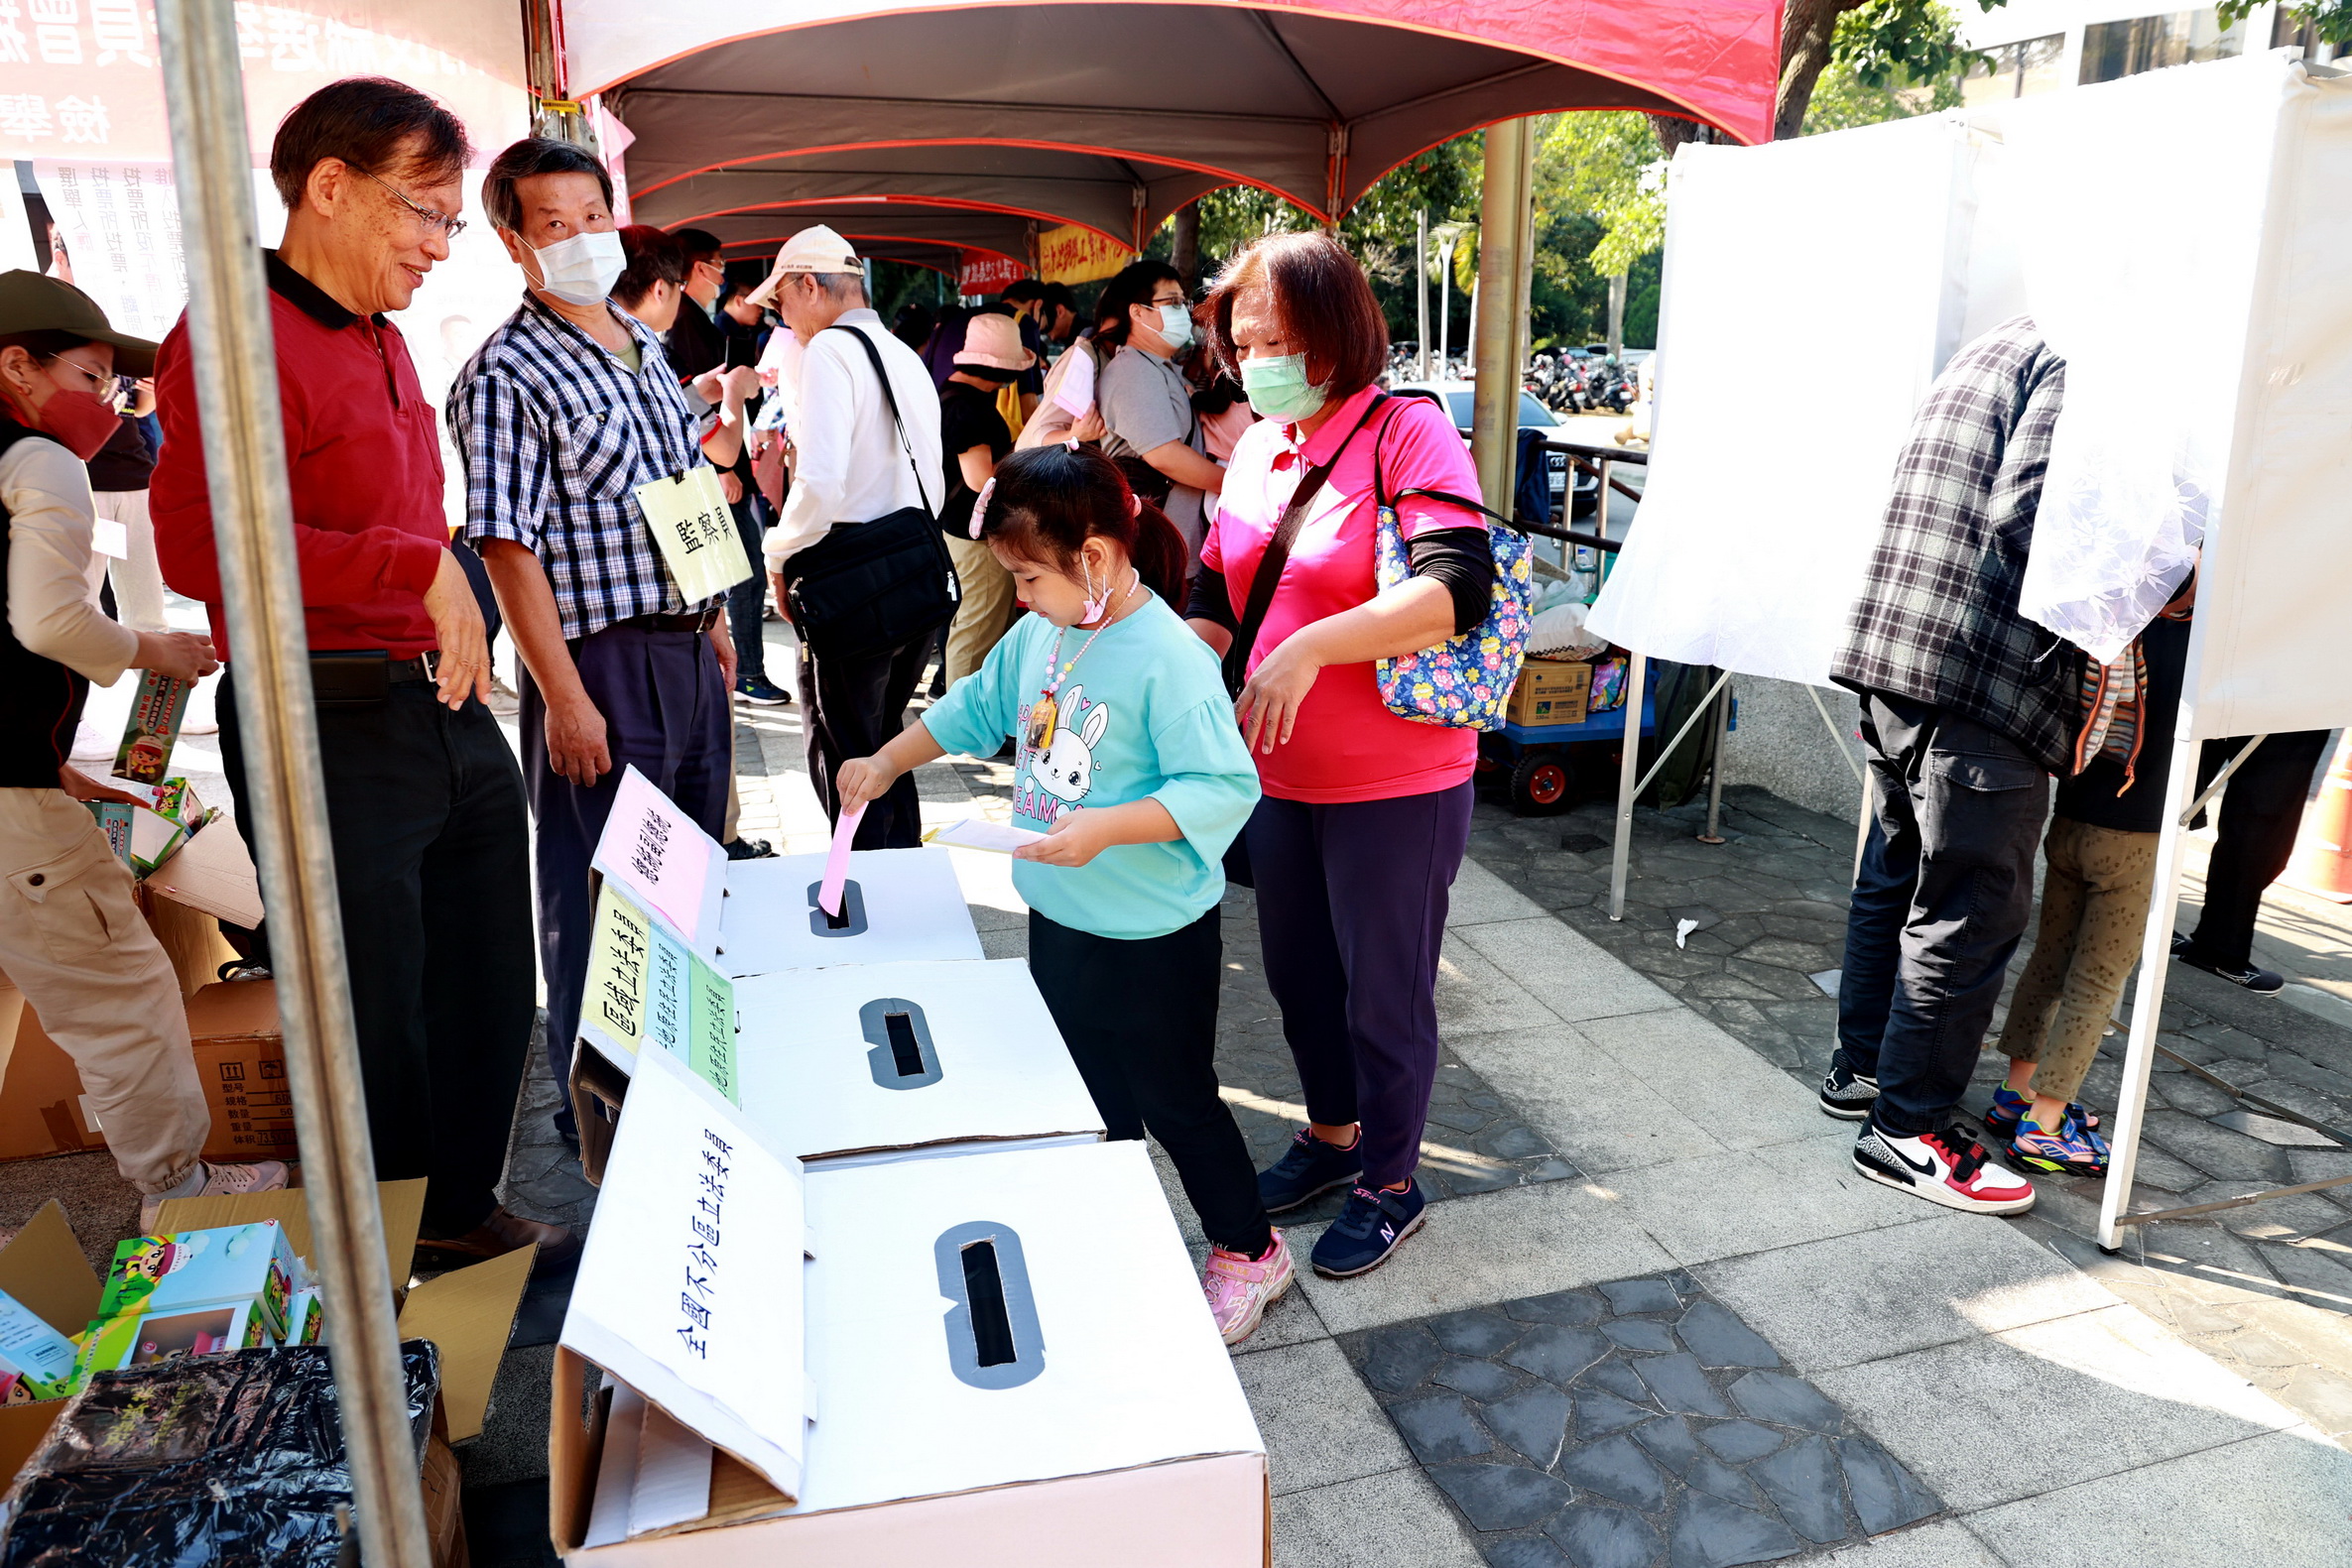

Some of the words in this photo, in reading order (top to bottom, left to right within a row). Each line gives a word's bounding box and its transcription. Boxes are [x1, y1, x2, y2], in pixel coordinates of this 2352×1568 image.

[675, 506, 734, 555] 監察員
[631, 807, 673, 886] 總統副總統
[603, 908, 648, 1036] 區域立法委員
[704, 984, 728, 1098] 地原住民立法委員
[225, 1096, 248, 1107] 规格
[274, 1094, 292, 1104] 50
[228, 1109, 252, 1120] 数量
[230, 1122, 254, 1132] 重量
[233, 1134, 255, 1145] 体积
[1352, 1187, 1382, 1205] Sport
[677, 1129, 733, 1360] 全國不分區立法委員
[1379, 1221, 1396, 1245] N
